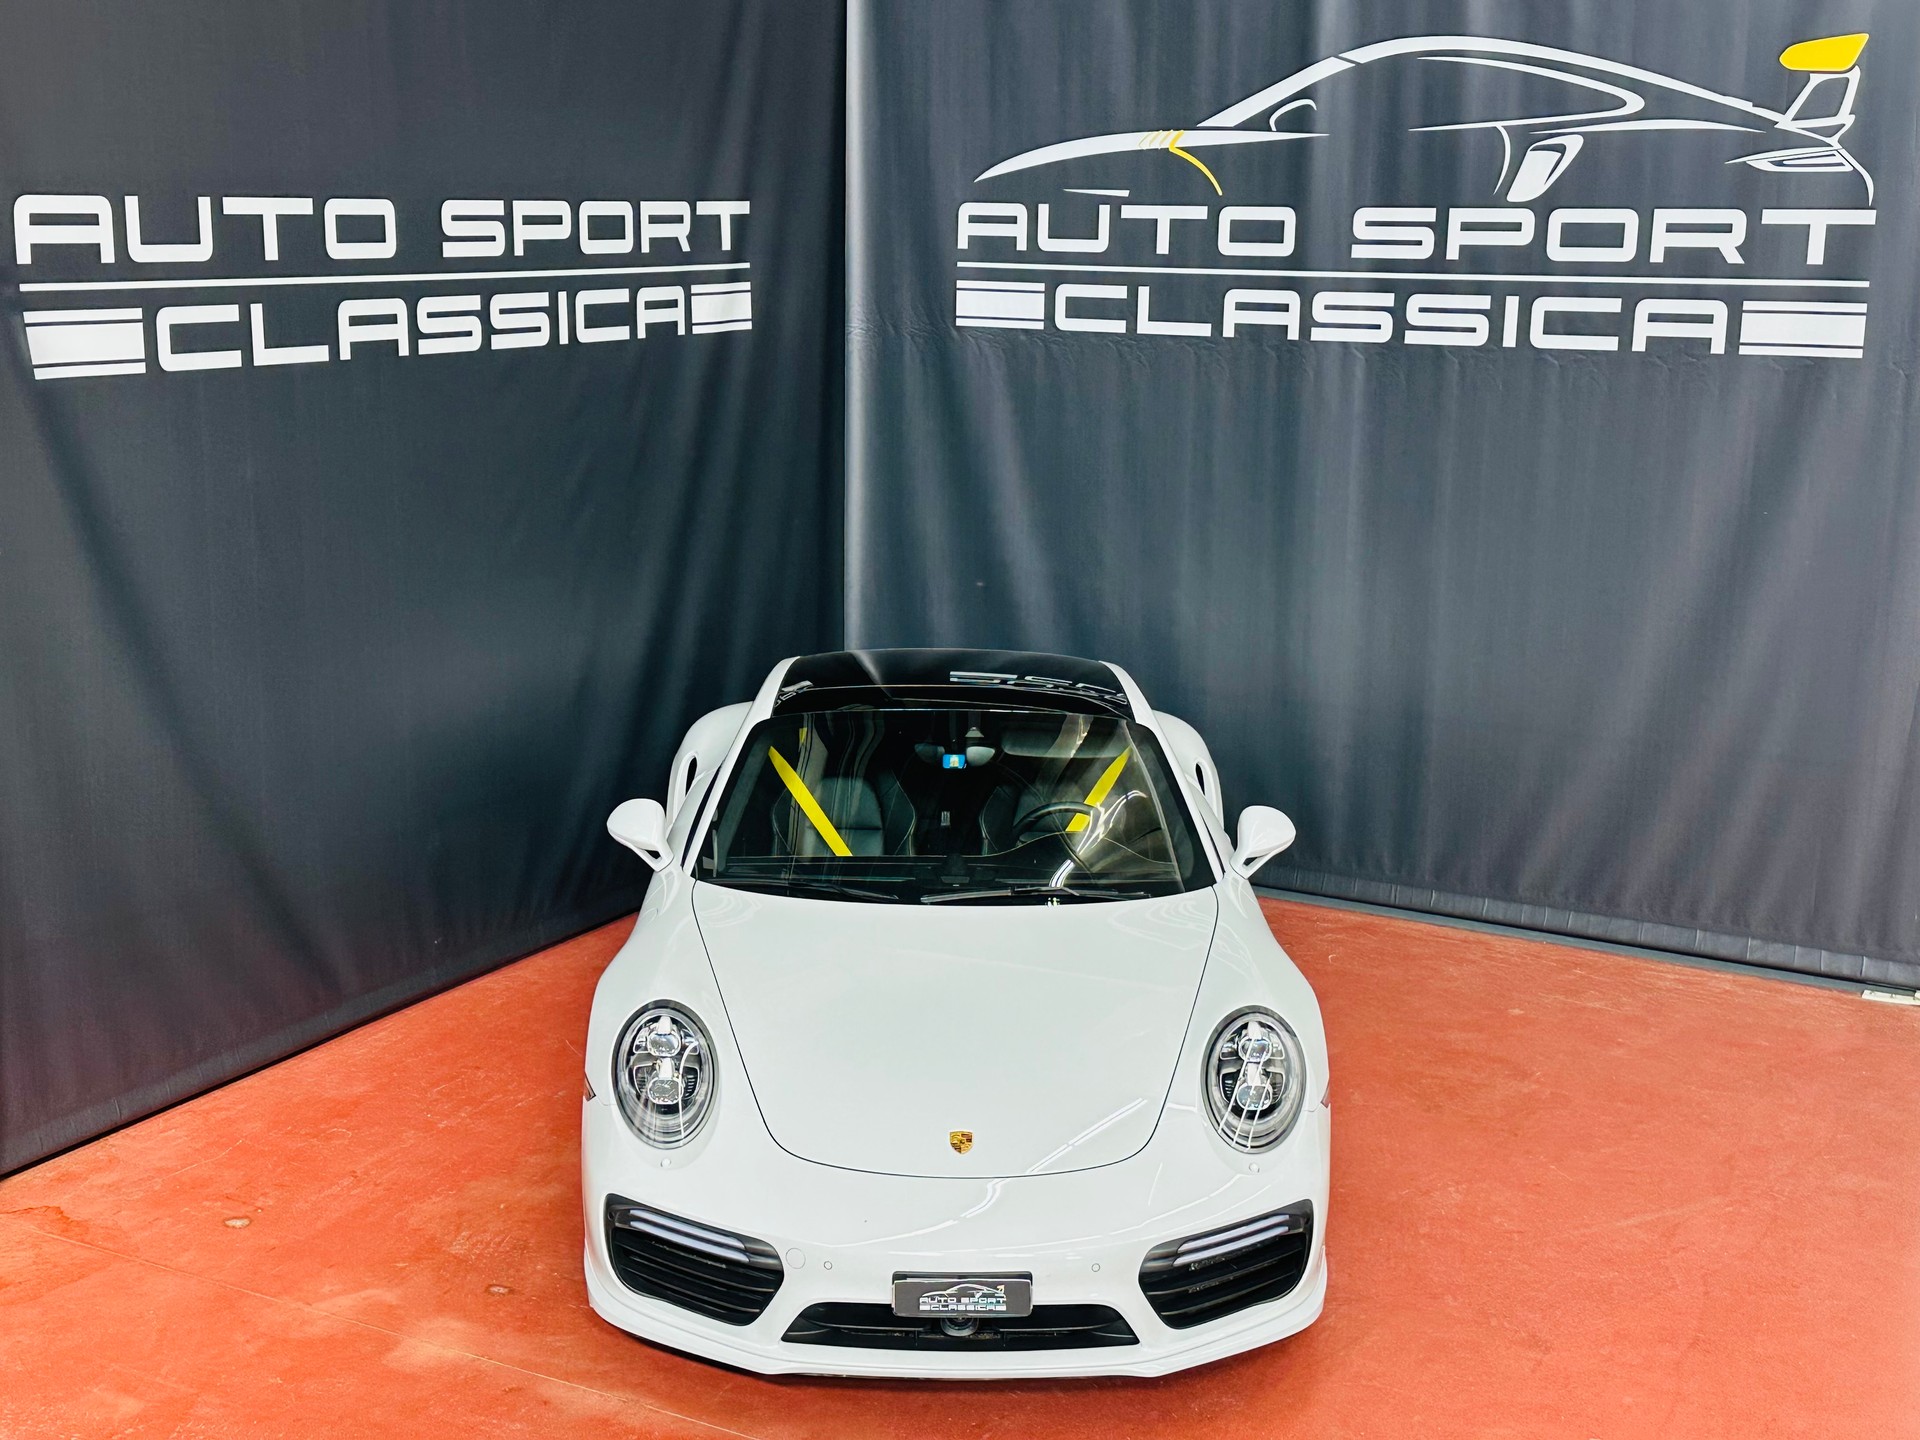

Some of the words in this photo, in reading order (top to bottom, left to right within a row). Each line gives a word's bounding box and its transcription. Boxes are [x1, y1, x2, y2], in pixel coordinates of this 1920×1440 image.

[14, 194, 397, 265] AUTO
[440, 199, 750, 258] SPORT
[956, 202, 1297, 258] AUTO
[1350, 206, 1877, 266] SPORT
[156, 285, 687, 372] CLASSICA
[1054, 282, 1728, 355] CLASSICA
